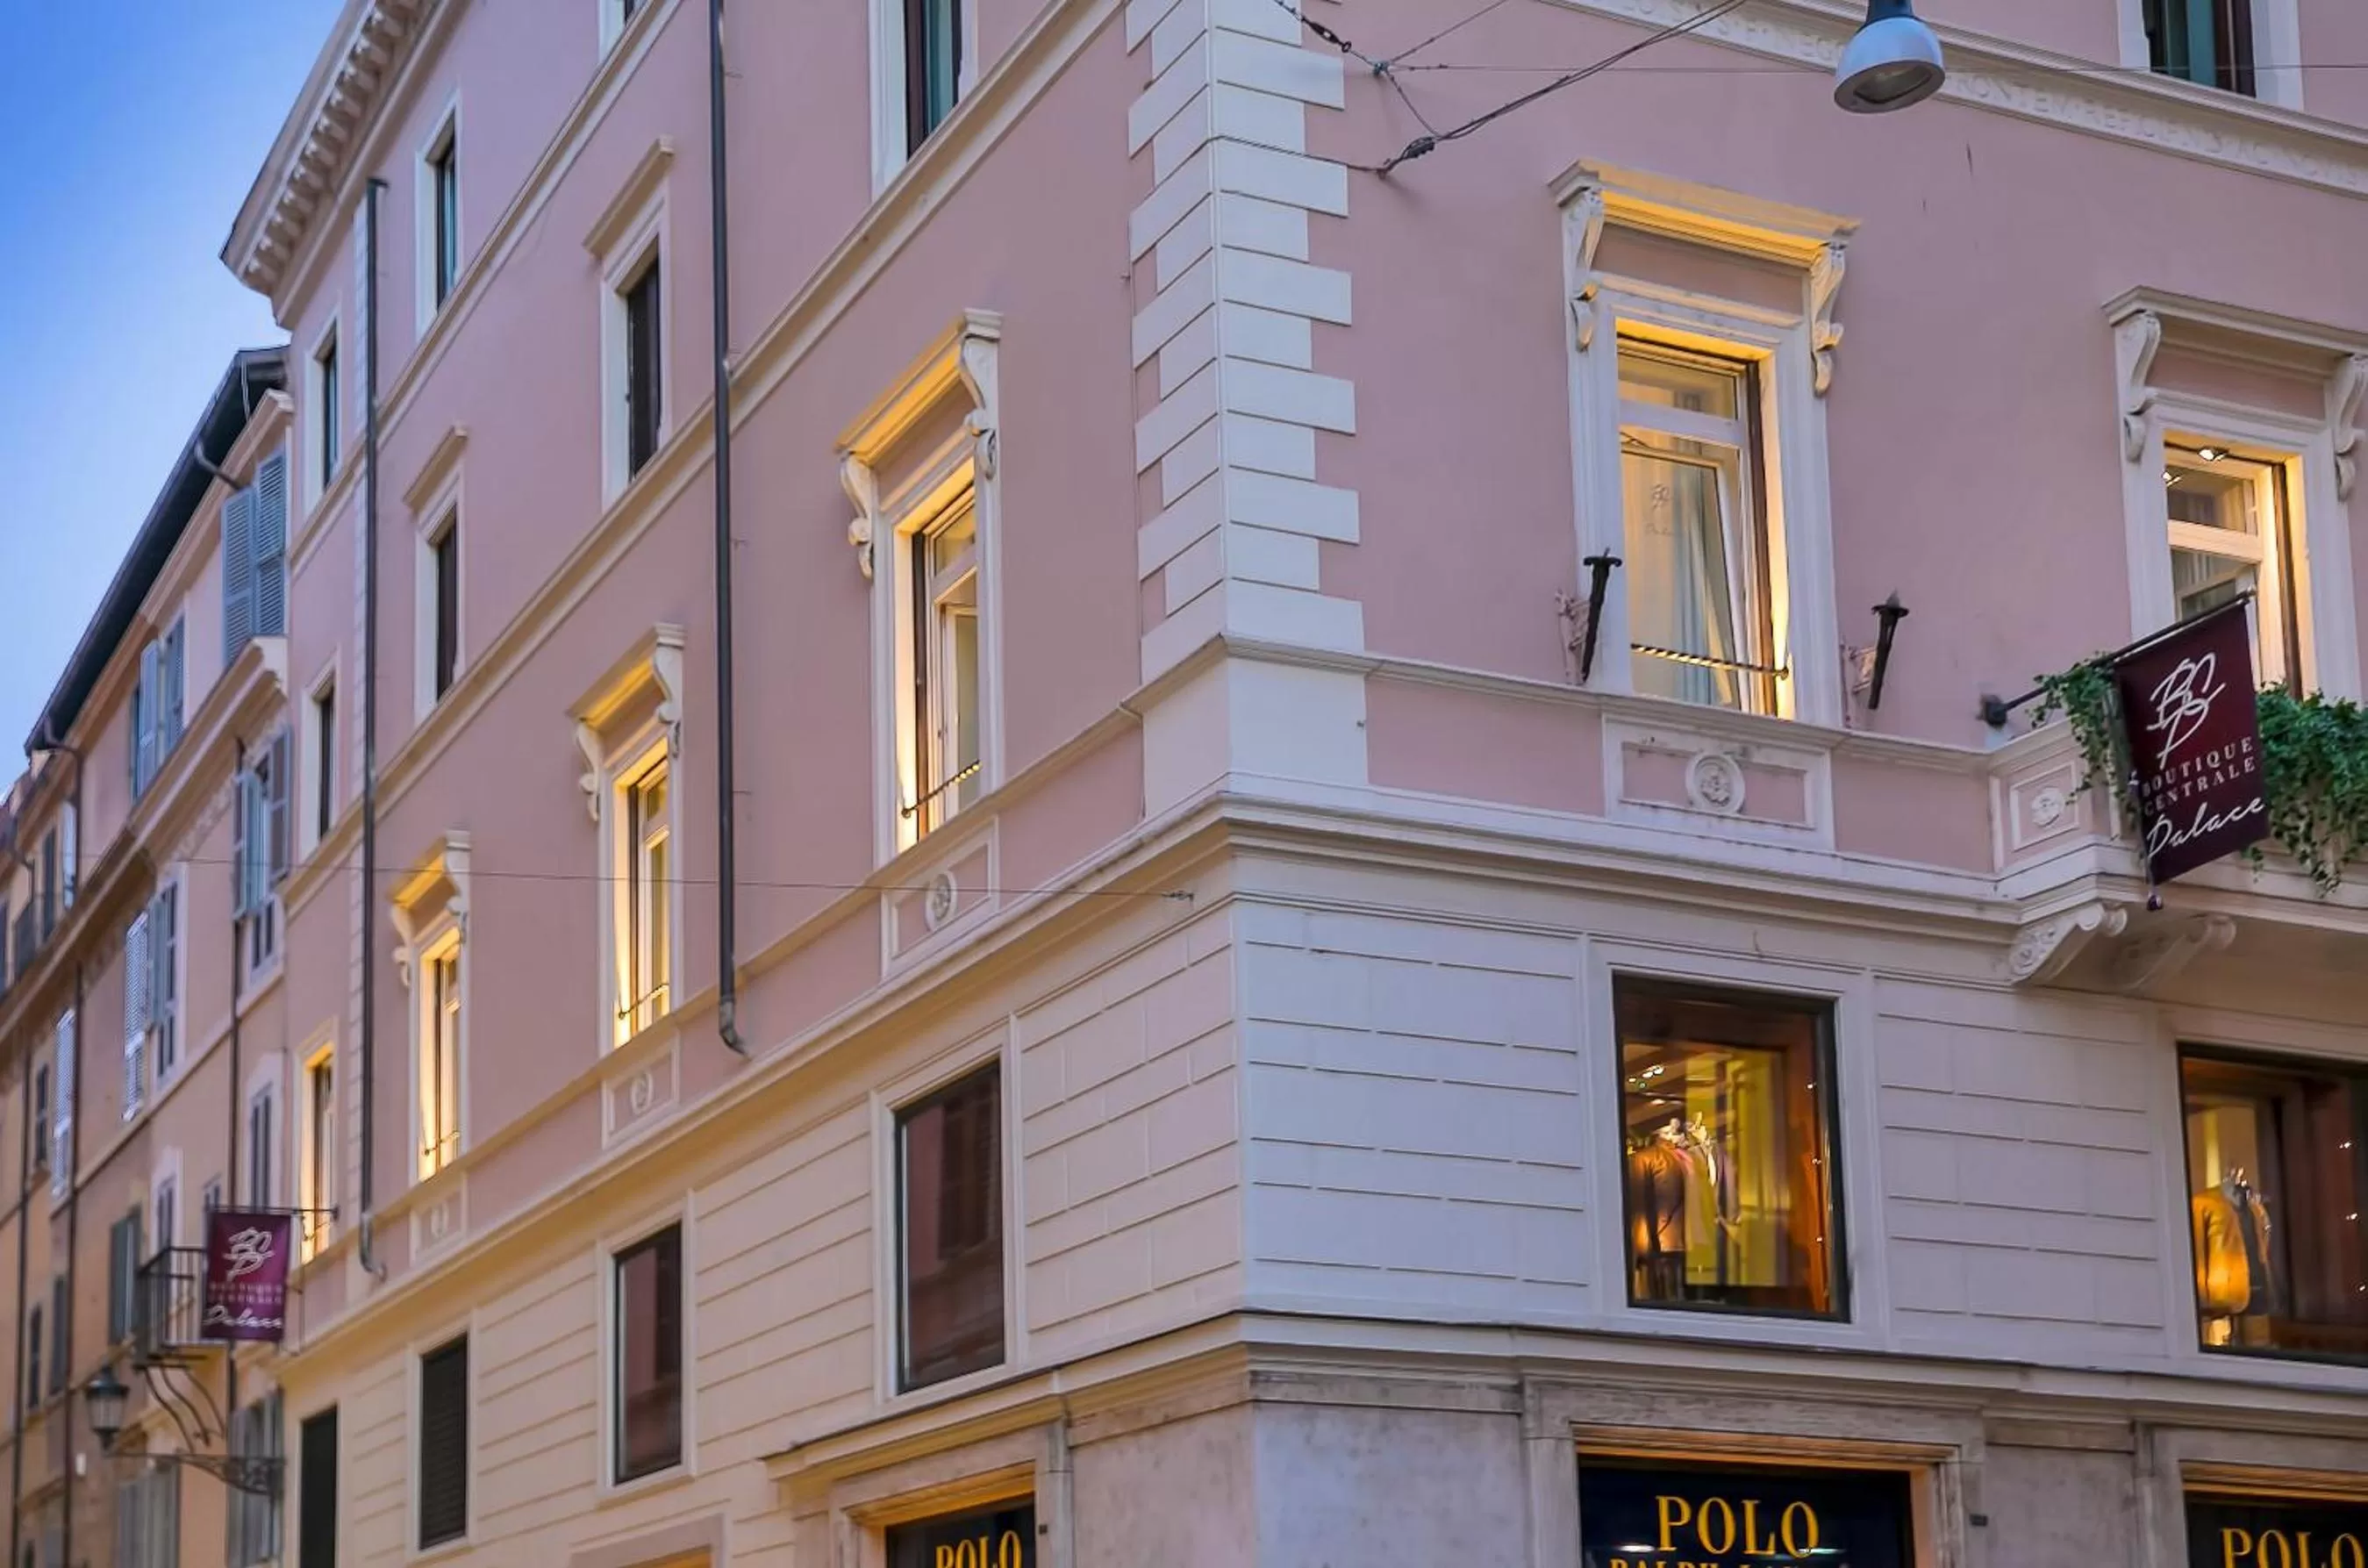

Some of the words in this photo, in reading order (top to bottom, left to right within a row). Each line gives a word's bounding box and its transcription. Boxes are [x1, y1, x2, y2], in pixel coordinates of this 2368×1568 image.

[2142, 736, 2253, 798] BOUTIQUE
[2144, 756, 2256, 817] CENTRALE
[2147, 797, 2265, 860] Palace
[1656, 1495, 1820, 1559] POLO
[2219, 1528, 2364, 1568] POLO
